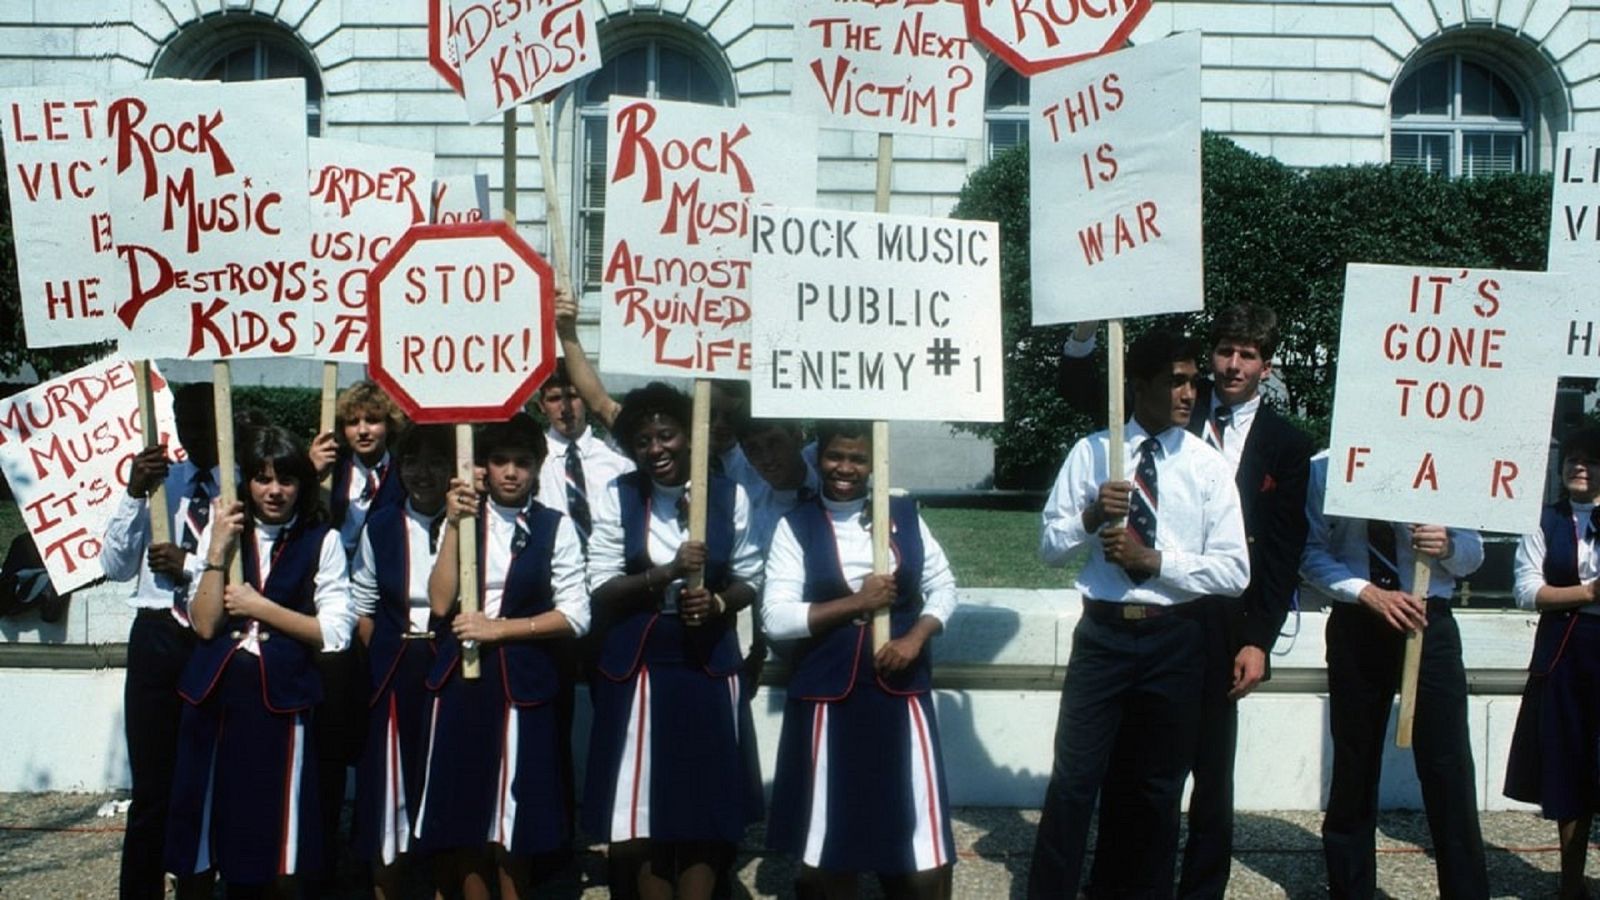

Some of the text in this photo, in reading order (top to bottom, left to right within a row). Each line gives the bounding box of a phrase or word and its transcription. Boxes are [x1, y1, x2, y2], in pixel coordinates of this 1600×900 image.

[809, 11, 971, 59] THE NEXT
[1042, 73, 1124, 142] THIS
[107, 97, 235, 201] ROCK
[611, 102, 755, 203] ROCK
[1082, 143, 1117, 190] IS
[17, 156, 107, 201] VIC
[660, 177, 750, 246] MUSI
[1078, 201, 1161, 265] WAR
[310, 232, 391, 263] USIC
[604, 239, 752, 288] ALMOST
[752, 215, 989, 267] ROCK MUSIC
[45, 278, 104, 320] HE
[117, 244, 307, 331] DESTROYS
[405, 263, 516, 305] STOP
[798, 282, 951, 329] PUBLIC
[1409, 270, 1501, 318] IT'S
[187, 297, 297, 357] KIDS
[1383, 323, 1507, 369] GONE
[403, 328, 531, 375] ROCK!
[772, 349, 916, 391] ENEMY
[1395, 379, 1486, 422] TOO
